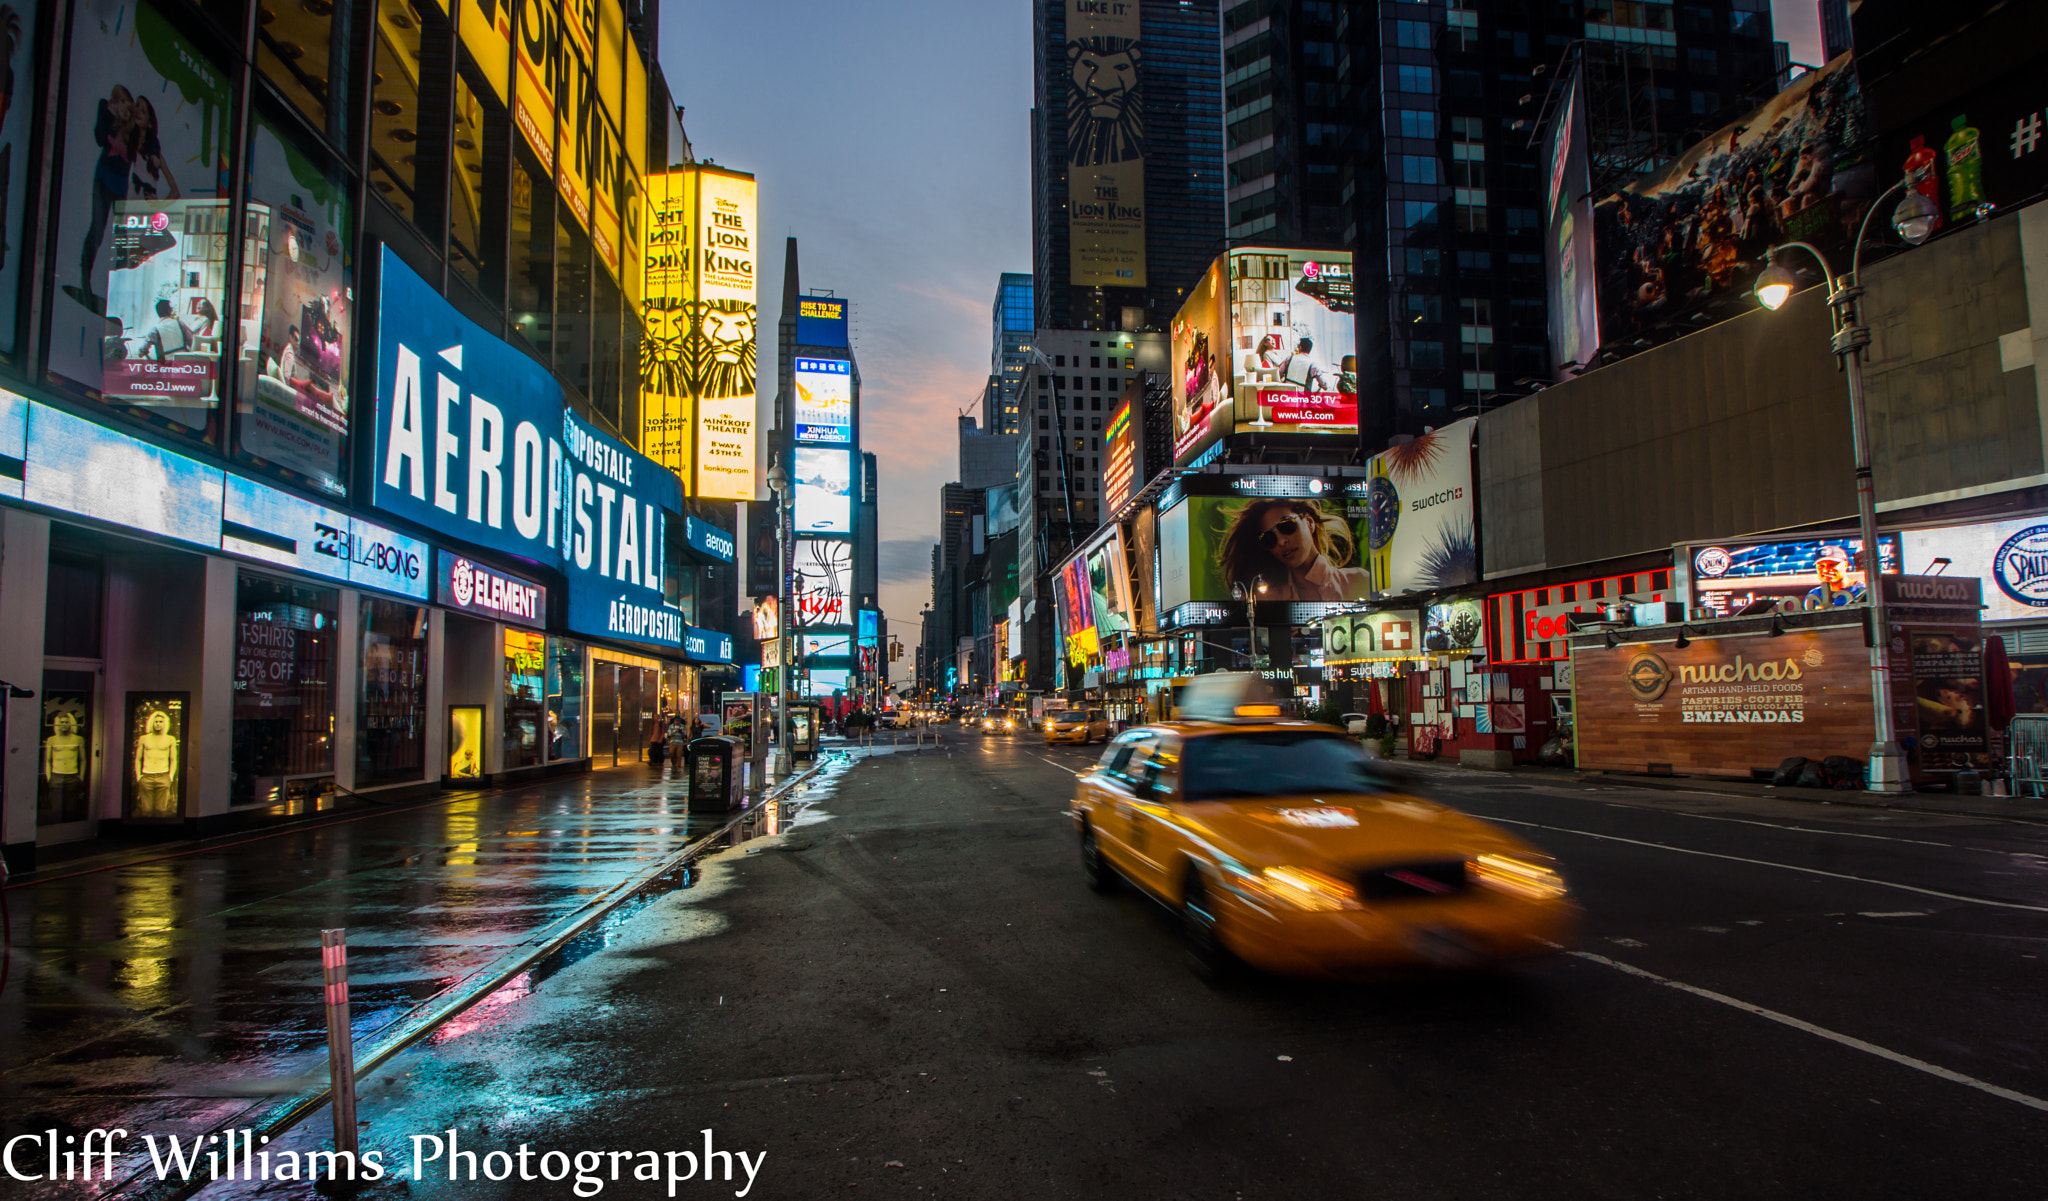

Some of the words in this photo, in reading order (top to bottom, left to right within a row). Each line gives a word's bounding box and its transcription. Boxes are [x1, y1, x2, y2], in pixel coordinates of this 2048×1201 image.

[1077, 1, 1107, 14] LIKE
[179, 49, 215, 89] STARS
[518, 104, 553, 167] ENTRANCE
[560, 174, 572, 197] ON
[1095, 186, 1118, 197] THE
[1072, 200, 1104, 219] LION
[1108, 202, 1141, 220] KING
[712, 212, 742, 227] THE
[707, 226, 748, 248] LION
[704, 249, 752, 274] KING
[1322, 265, 1341, 276] LG
[704, 279, 732, 287] MUSICAL
[717, 275, 752, 285] LANDMARK
[800, 301, 817, 310] RISE
[817, 302, 826, 310] TO
[828, 303, 842, 312] THE
[800, 309, 842, 319] CHALLENGE.
[1267, 394, 1279, 403] LG
[1279, 394, 1309, 404] Cinema
[1311, 395, 1322, 404] 3D
[1324, 396, 1337, 404] TV
[1277, 411, 1334, 421] www.LG.com
[703, 417, 751, 428] MINSKOFF
[1105, 400, 1130, 447] MOTOWN
[706, 424, 748, 435] THEATRE
[807, 426, 839, 434] XINHUA
[800, 432, 819, 440] NEWS
[820, 433, 846, 441] AGENCY
[709, 449, 731, 457] 45TH
[703, 464, 749, 475] lionking.com
[1240, 479, 1256, 489] hut
[1412, 489, 1454, 511] swatch
[2014, 528, 2034, 543] FIRST
[338, 530, 420, 580] BILLABONG
[1896, 576, 1969, 600] nuchas
[475, 569, 538, 619] ELEMENT
[241, 622, 296, 648] T-SHIRTS
[1915, 659, 1980, 667] EMPANADAS
[239, 659, 267, 680] 50%
[269, 661, 294, 680] OFF
[1277, 668, 1294, 679] hut
[1351, 665, 1390, 676] swatch
[1678, 655, 1803, 684] nuchas
[1682, 686, 1717, 694] ARTISAN
[1718, 684, 1769, 694] HAND-HELD
[1772, 683, 1803, 692] FOODS
[1682, 710, 1804, 723] EMPANADAS
[1939, 734, 1984, 744] nuchas
